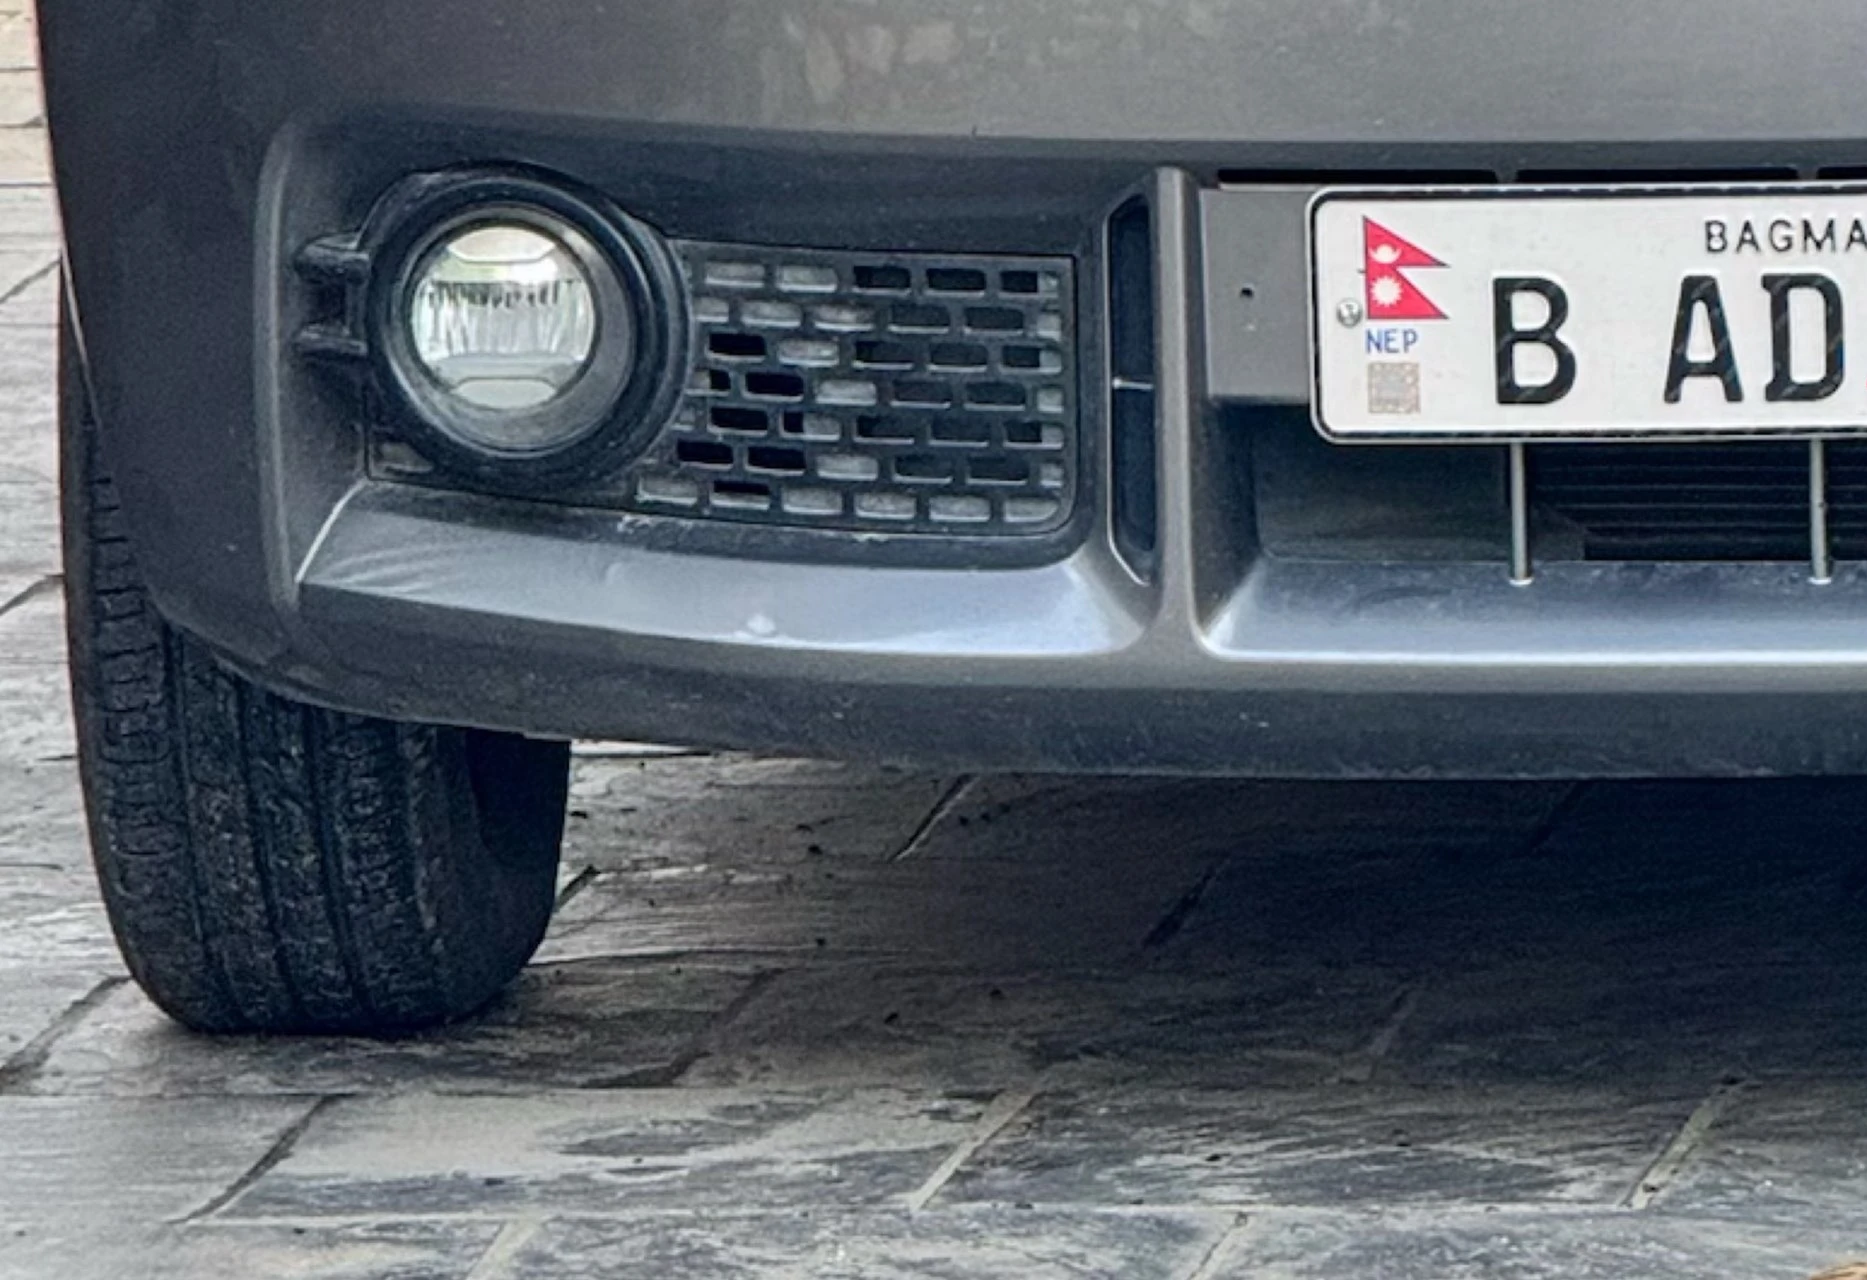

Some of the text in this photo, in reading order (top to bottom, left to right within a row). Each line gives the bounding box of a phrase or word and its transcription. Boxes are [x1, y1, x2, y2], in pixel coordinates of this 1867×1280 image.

[1366, 328, 1418, 354] NEP
[1492, 275, 1577, 405] B
[1663, 272, 1845, 404] AD
